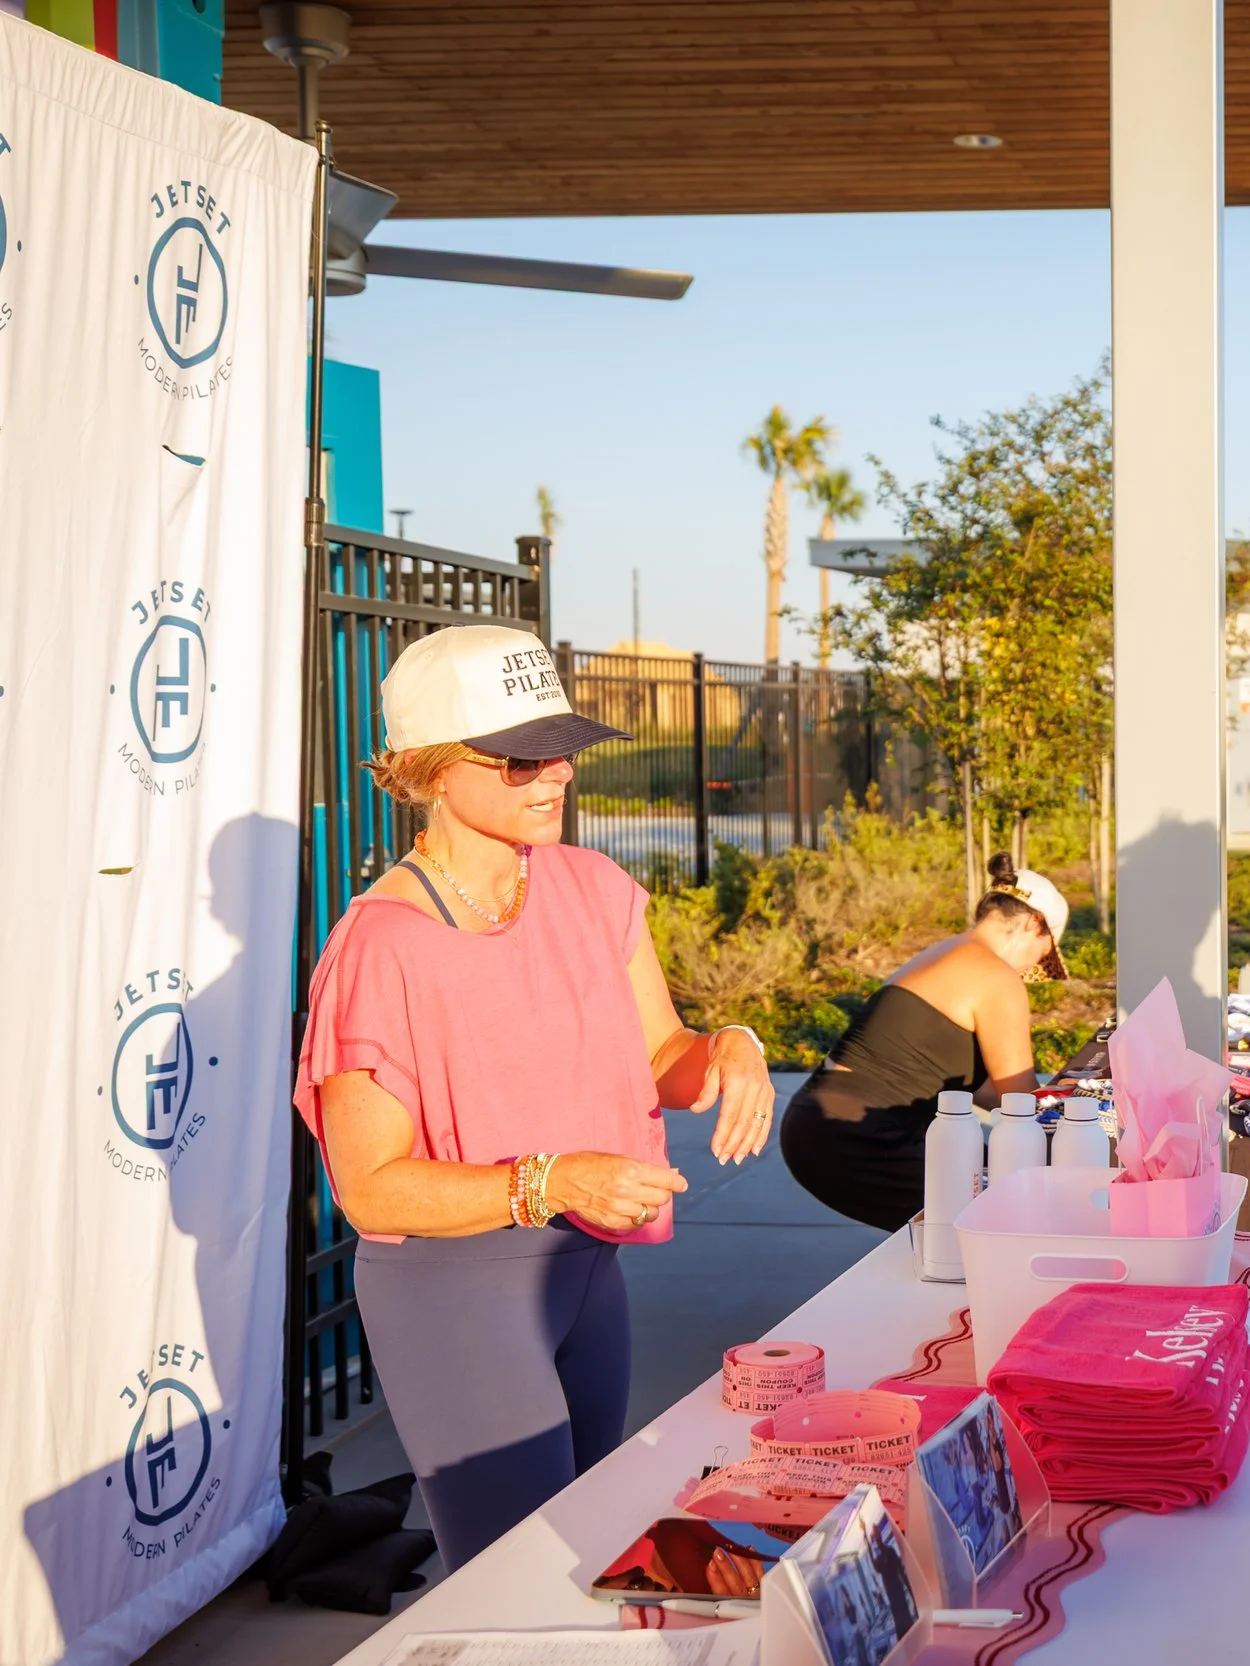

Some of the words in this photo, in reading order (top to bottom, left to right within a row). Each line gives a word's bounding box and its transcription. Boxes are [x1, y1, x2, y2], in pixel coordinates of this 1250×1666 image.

[150, 180, 232, 235] JETSET
[182, 356, 233, 401] PILATES
[114, 967, 194, 1022] JETST
[103, 1140, 167, 1182] MODERN
[119, 1343, 205, 1410] JESET
[756, 1403, 783, 1412] KET
[768, 1445, 803, 1456] TICKET
[812, 1444, 856, 1457] TICKET
[866, 1434, 911, 1452] TICKET
[742, 1456, 785, 1467] TICKET
[795, 1457, 840, 1469] TICKET
[850, 1465, 895, 1475] TICKET
